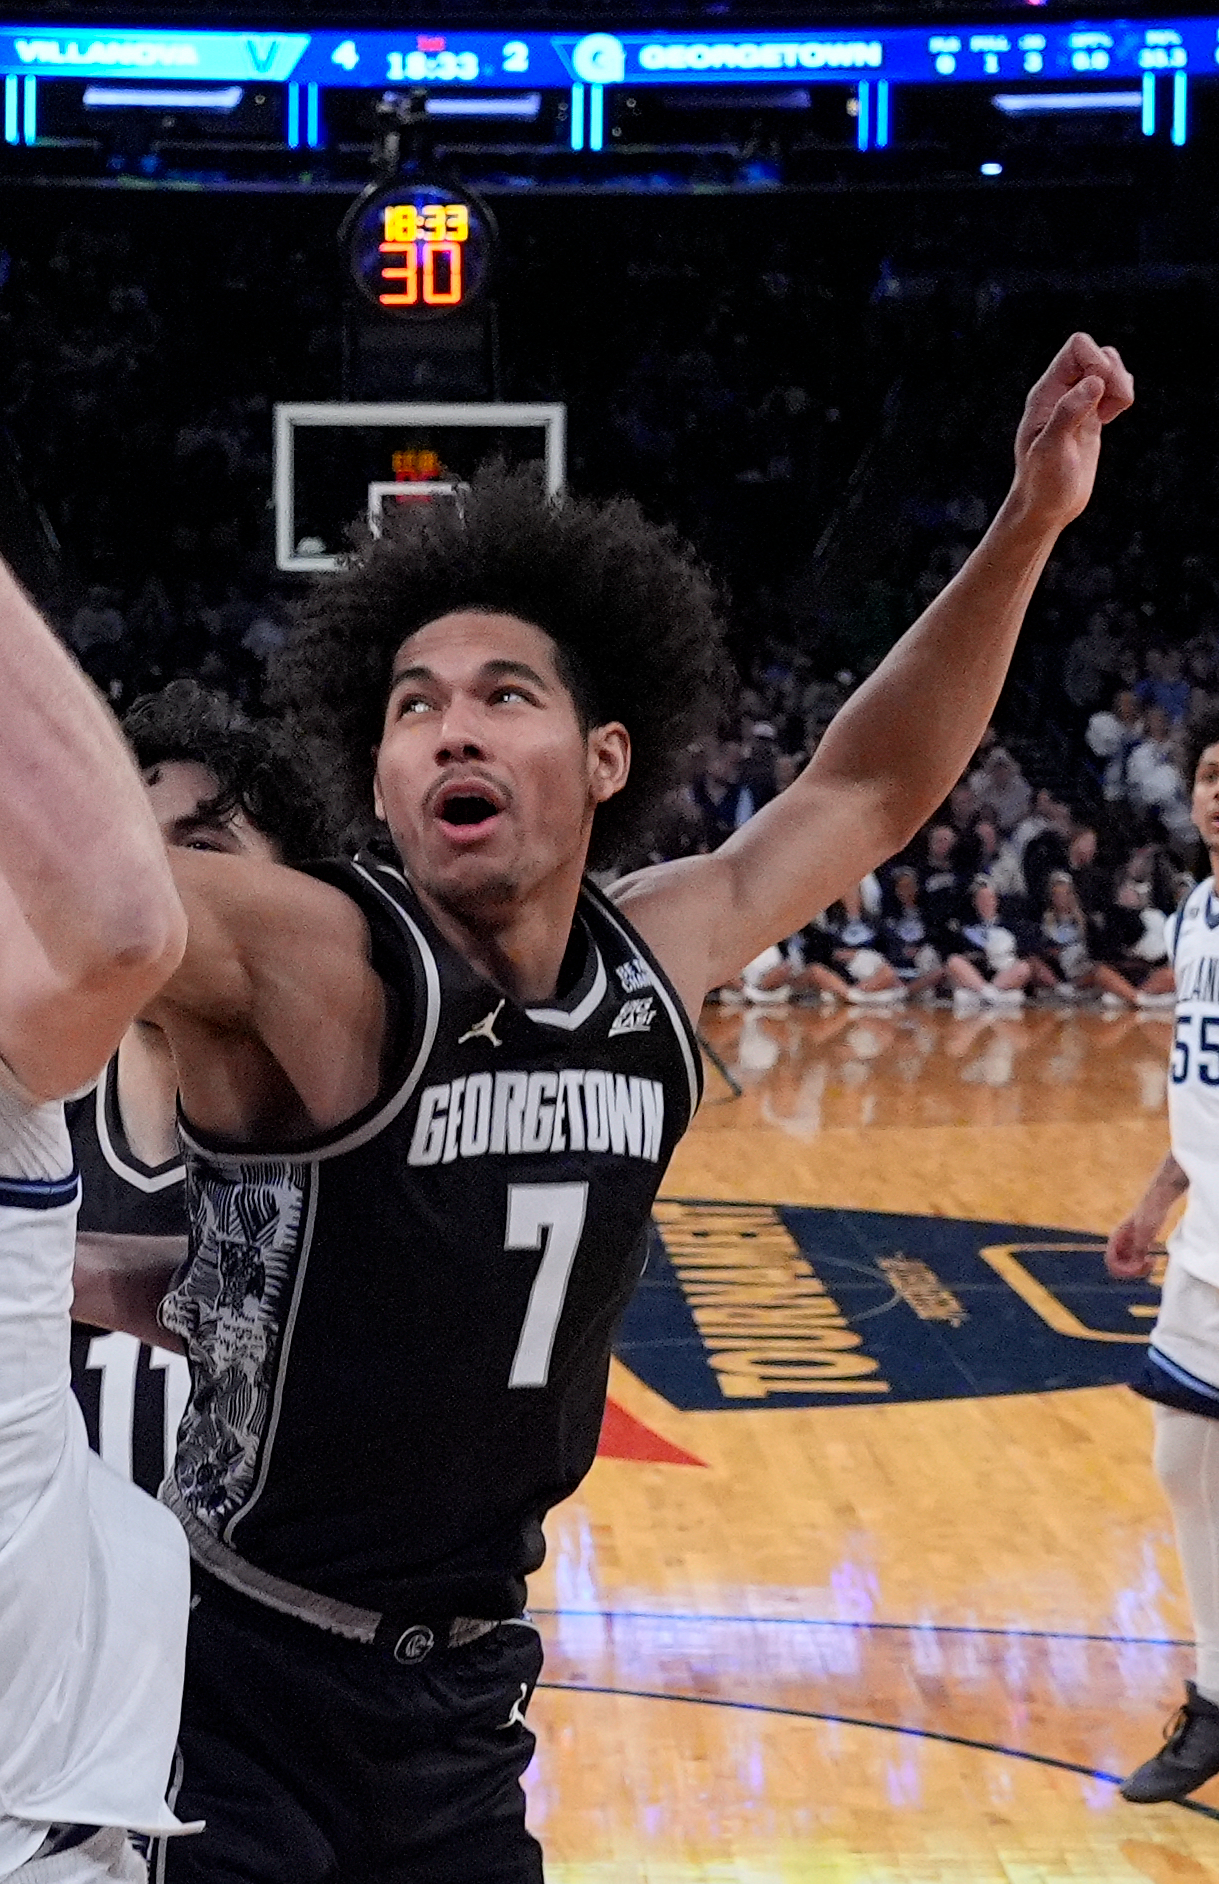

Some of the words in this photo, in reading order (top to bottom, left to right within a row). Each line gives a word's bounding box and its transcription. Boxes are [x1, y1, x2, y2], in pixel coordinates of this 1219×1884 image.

[14, 39, 201, 67] VILLANOVA
[331, 40, 361, 70] 4
[502, 40, 529, 72] 2
[639, 40, 883, 70] GEORGETOWN
[384, 204, 469, 242] 18:33
[378, 241, 462, 305] 30
[1171, 1015, 1219, 1086] 55
[407, 1068, 665, 1167] GEORGETOWN
[503, 1180, 590, 1389] 7
[84, 1330, 192, 1484] 11
